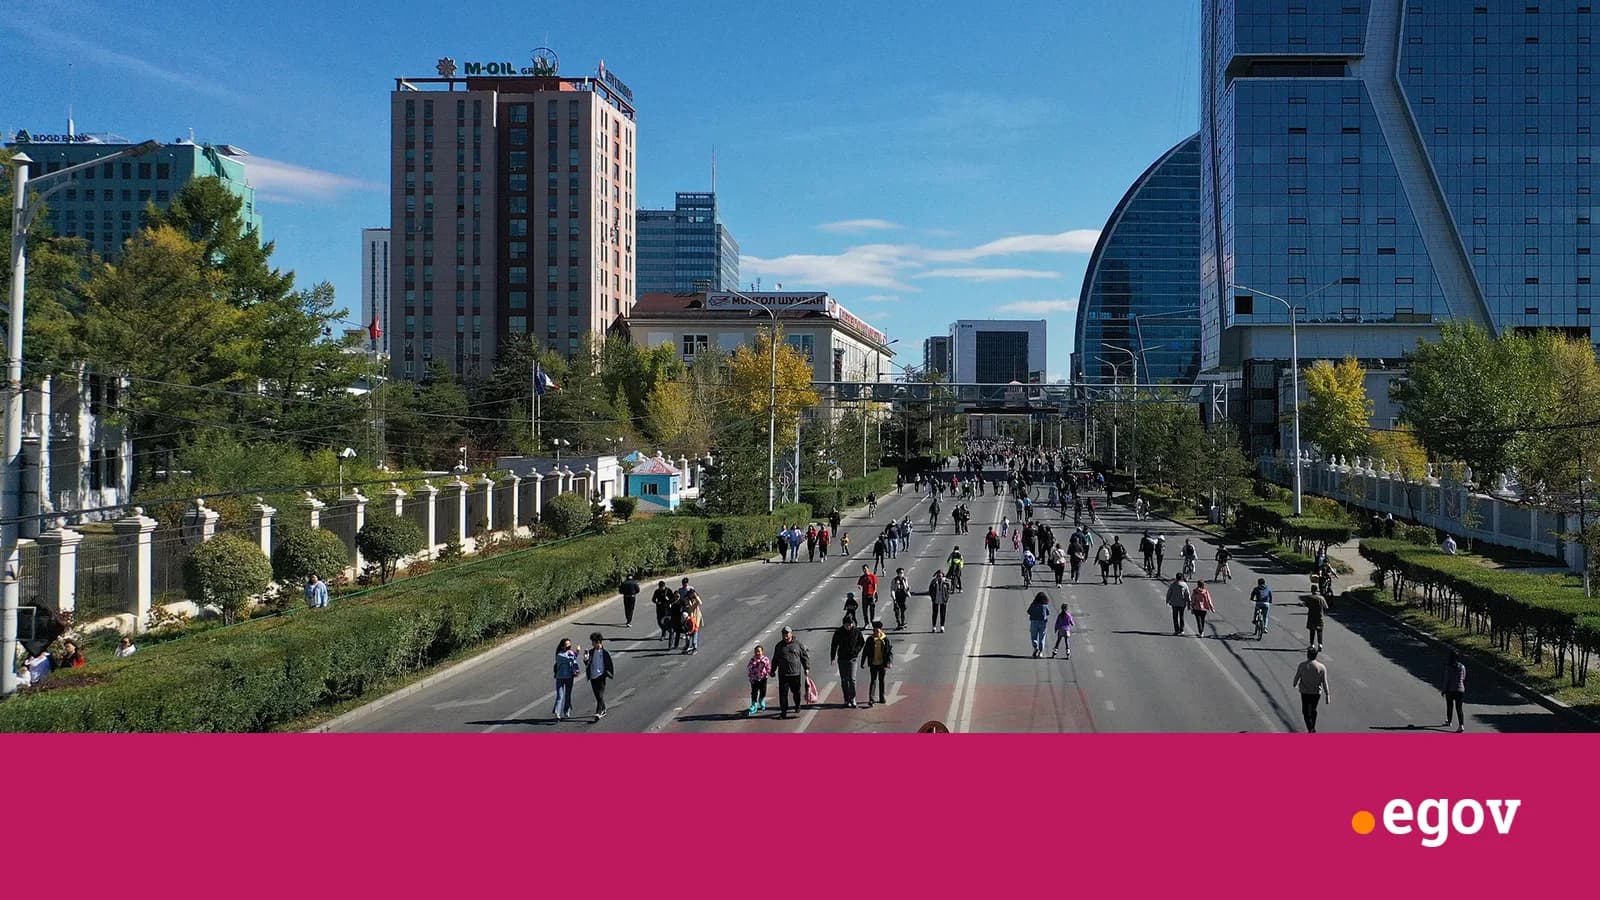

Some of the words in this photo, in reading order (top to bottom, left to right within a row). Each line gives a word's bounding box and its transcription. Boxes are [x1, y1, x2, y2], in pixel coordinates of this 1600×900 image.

[464, 62, 517, 75] M-OIL
[33, 134, 60, 142] BOGD
[732, 296, 776, 305] МОНГОЛ
